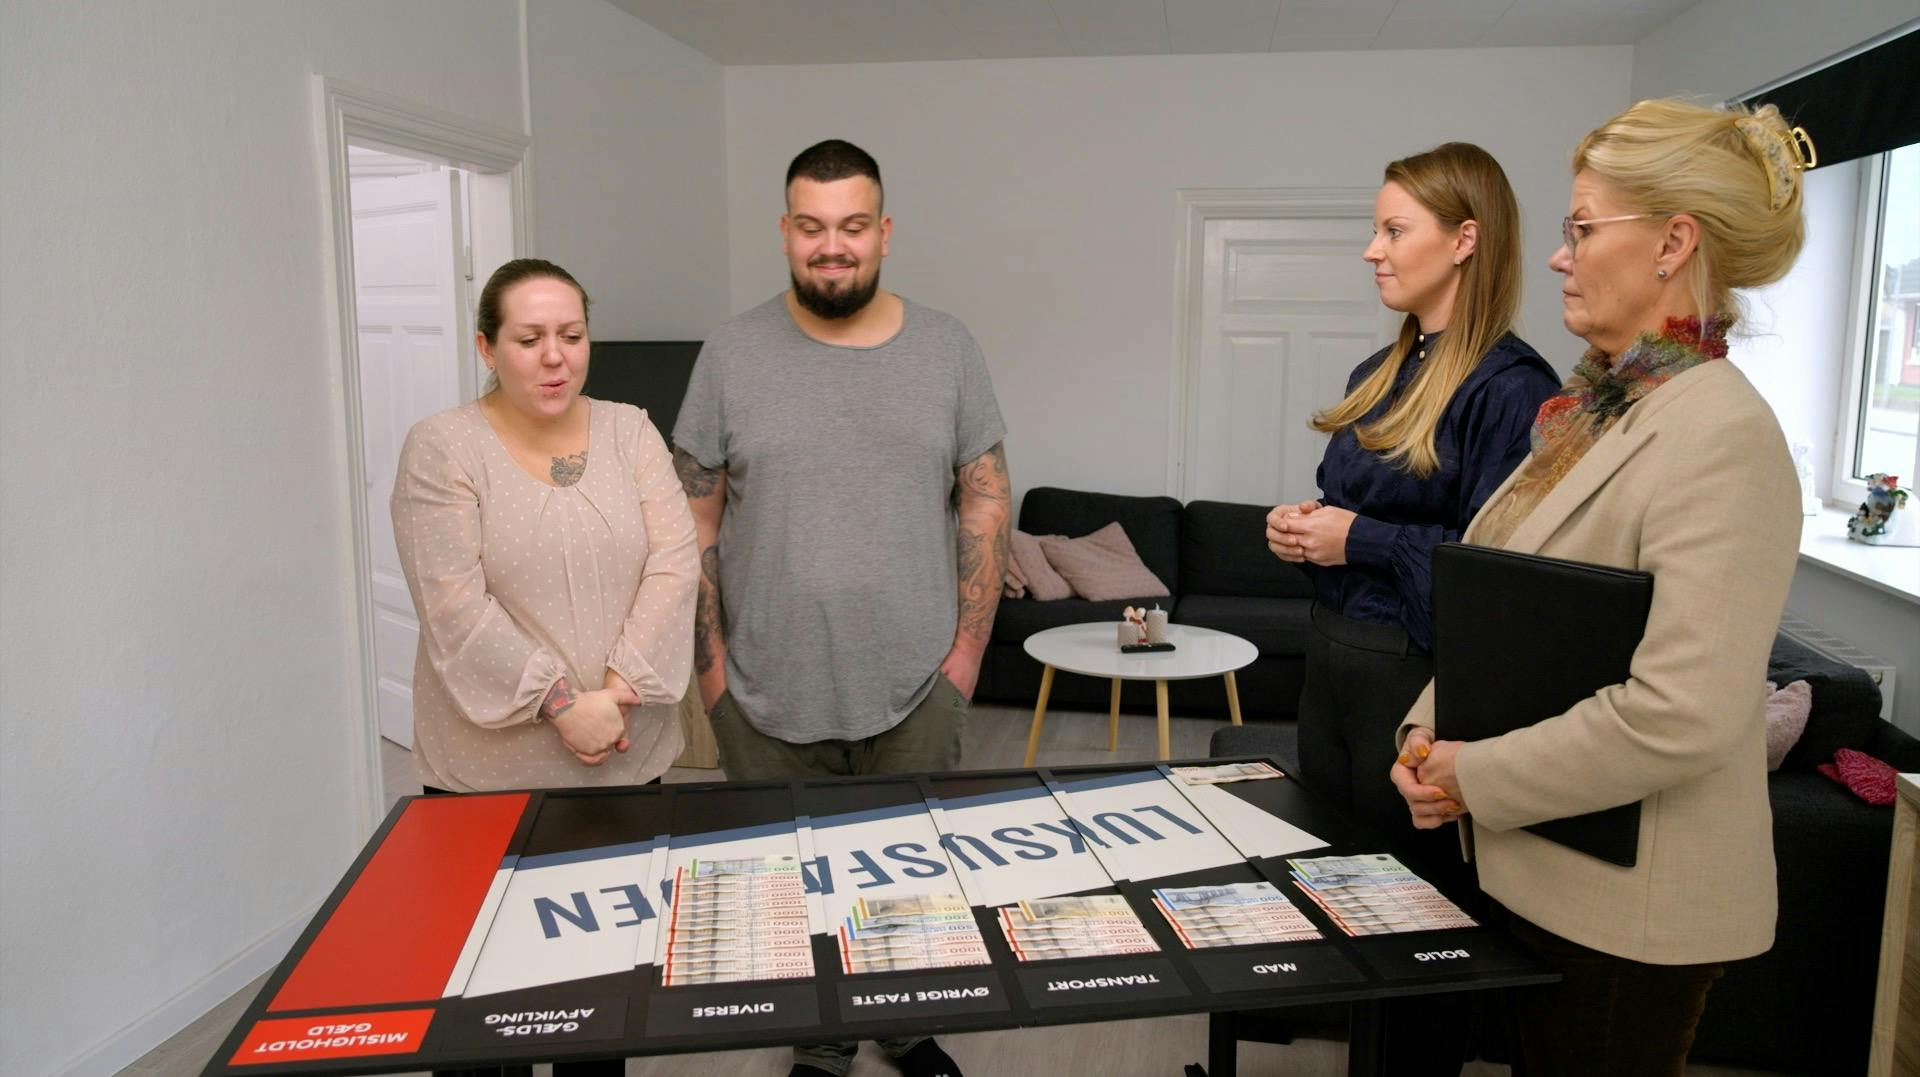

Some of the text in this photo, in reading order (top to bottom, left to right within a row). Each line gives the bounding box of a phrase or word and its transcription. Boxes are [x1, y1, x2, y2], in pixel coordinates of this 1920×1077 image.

[1414, 949, 1471, 962] BOLIG
[1252, 962, 1298, 974] MAD
[1047, 973, 1160, 992] TRANSPORT
[852, 986, 990, 1006] ØVRIGE FASTE
[484, 1007, 596, 1025] AFVIKLING
[692, 1002, 775, 1018] DIVERSE
[307, 1022, 372, 1036] GÆLD
[495, 1021, 579, 1037] GÆLDS-
[253, 1032, 408, 1054] MISLIGHOLDT
